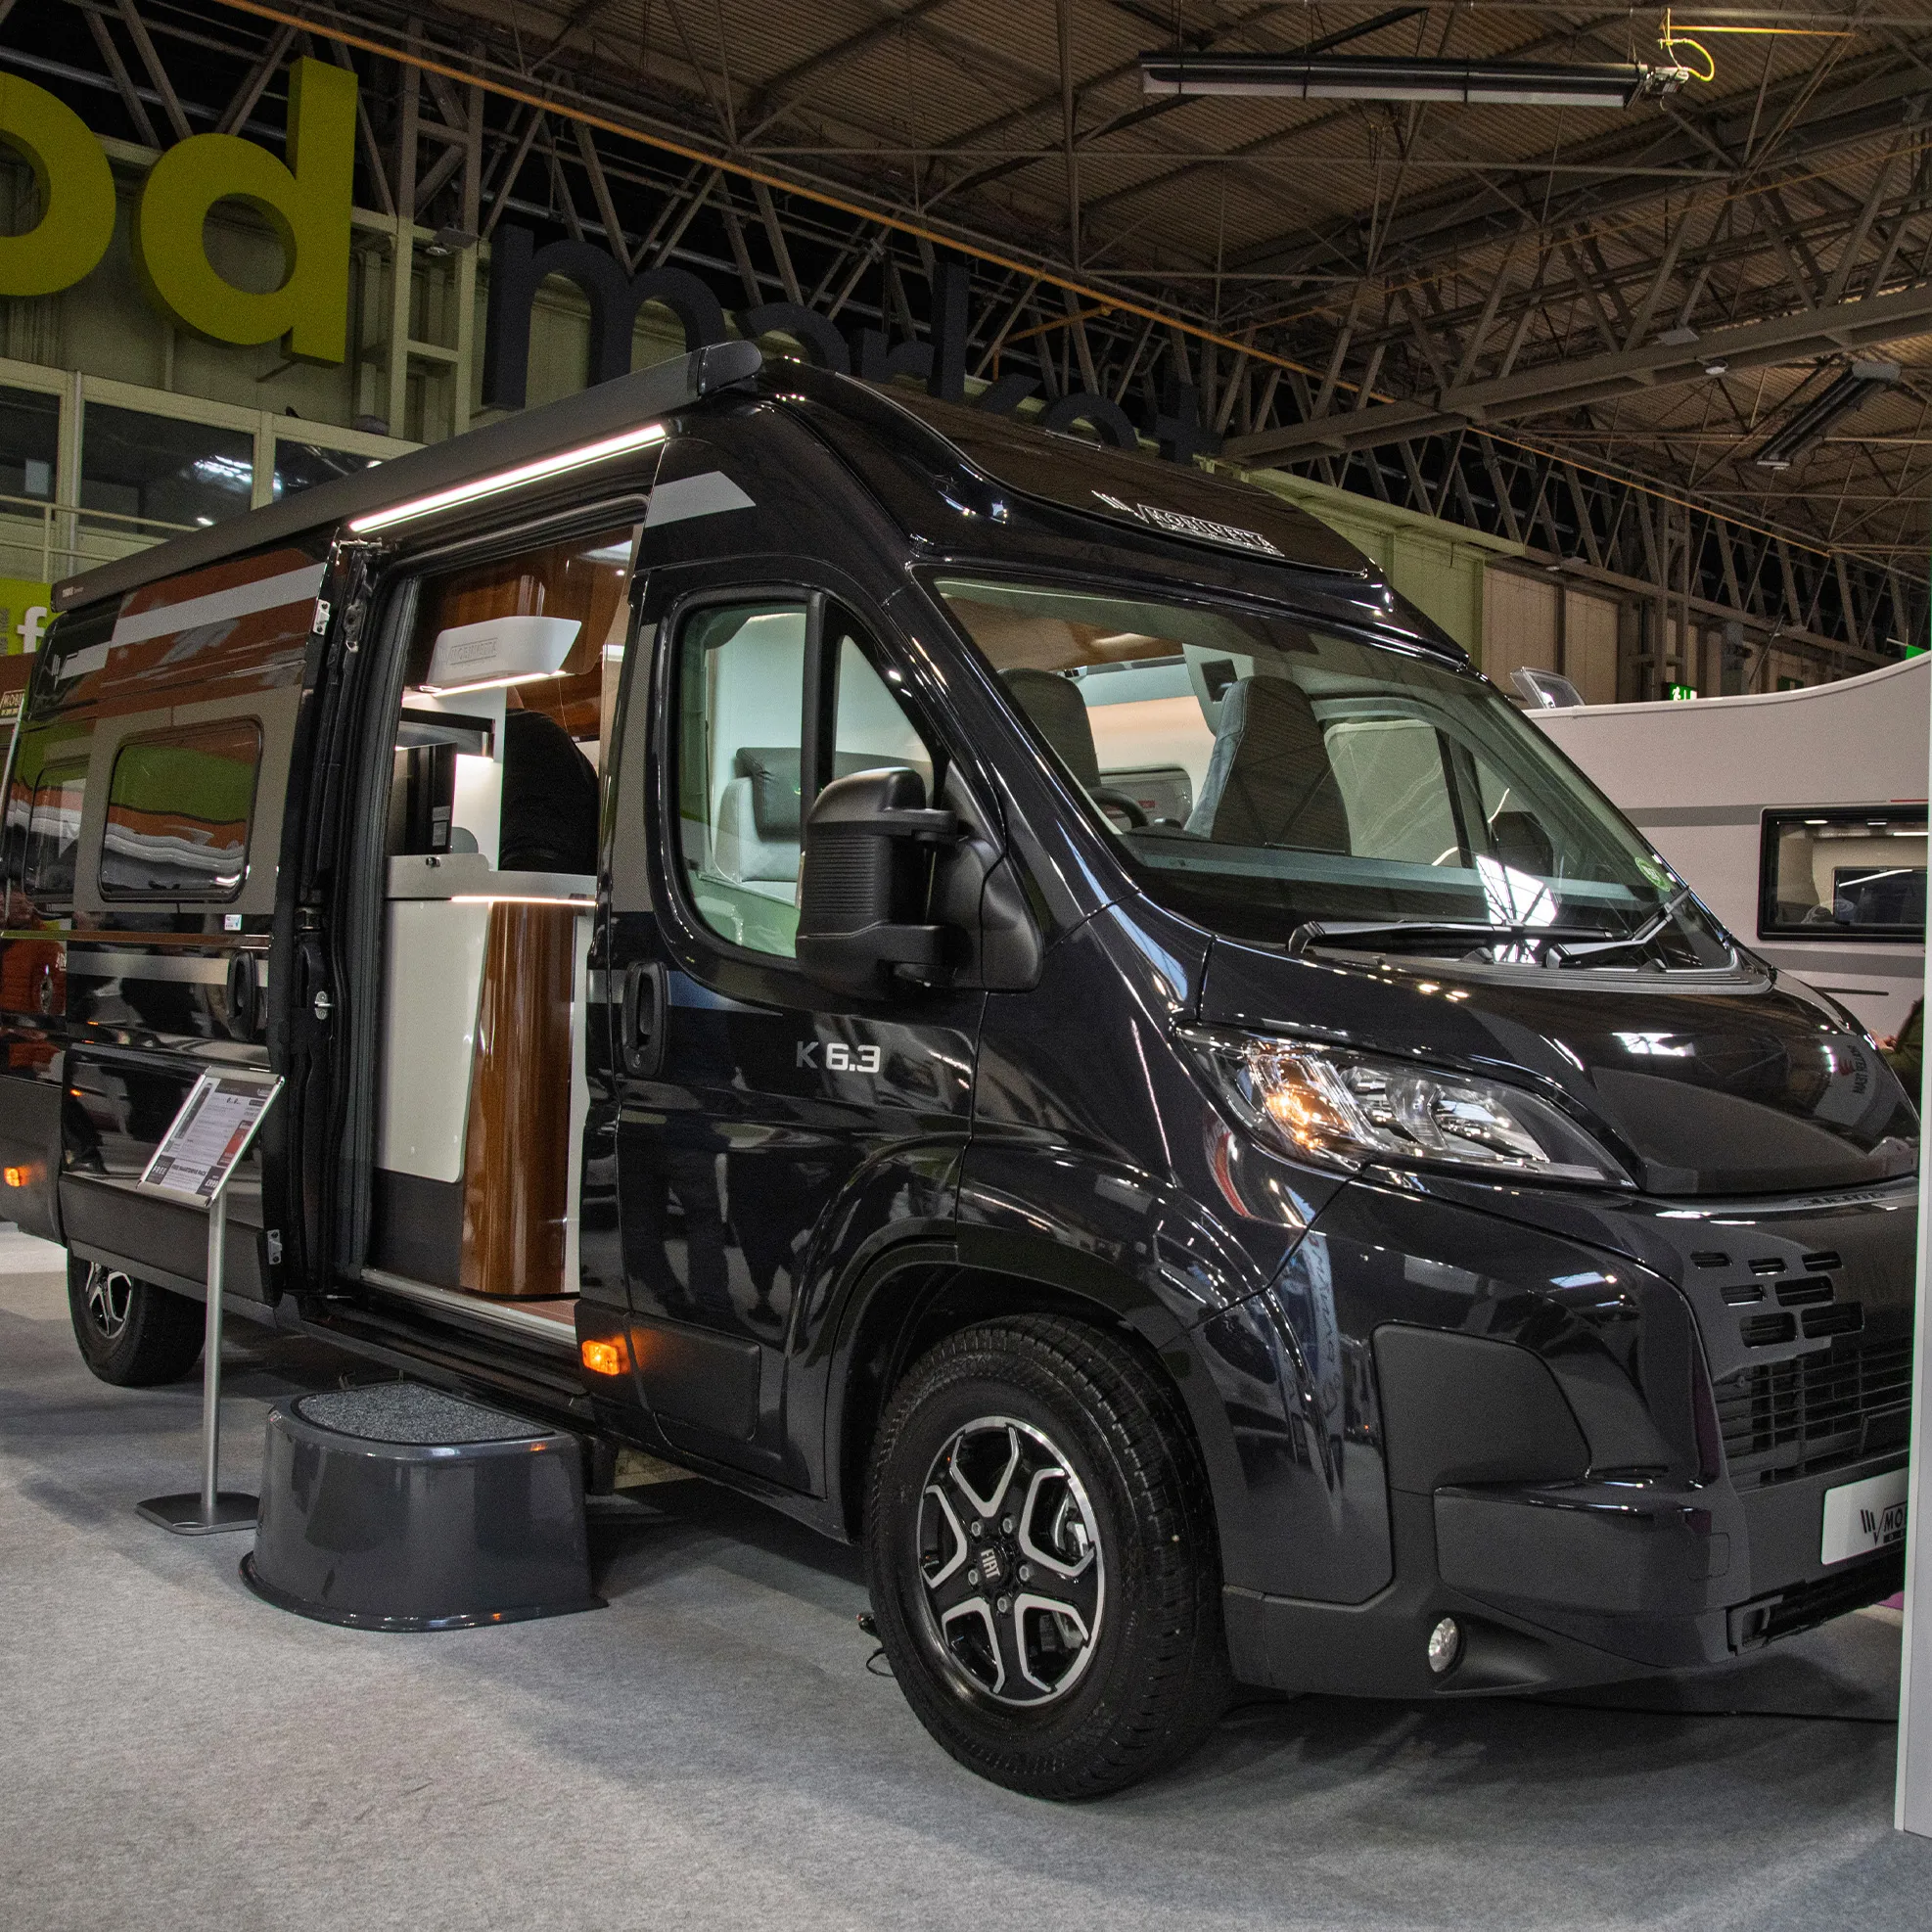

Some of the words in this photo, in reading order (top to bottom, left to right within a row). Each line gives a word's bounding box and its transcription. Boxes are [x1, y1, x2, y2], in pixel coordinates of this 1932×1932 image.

[796, 1040, 819, 1069] K
[825, 1042, 881, 1074] 6.3
[981, 1548, 1000, 1578] FIAT
